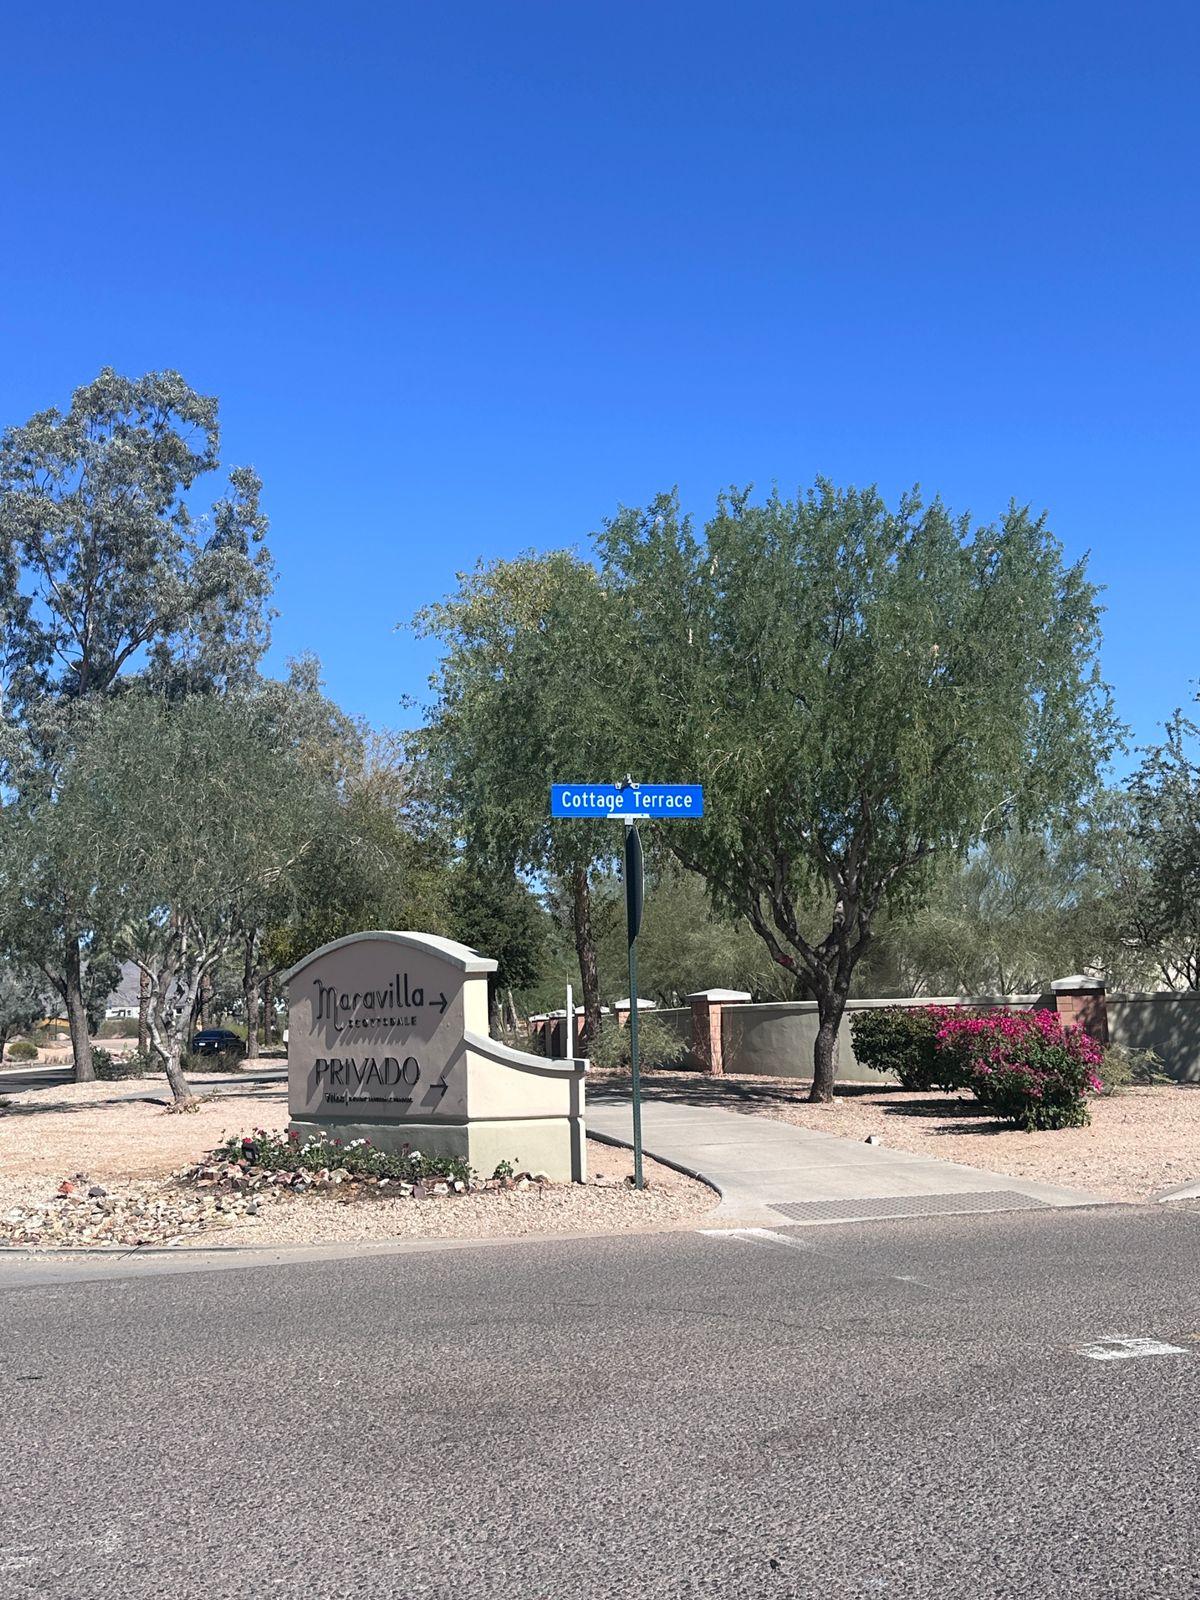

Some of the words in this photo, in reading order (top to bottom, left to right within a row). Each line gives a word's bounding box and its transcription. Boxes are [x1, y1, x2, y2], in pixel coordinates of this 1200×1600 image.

[562, 791, 624, 812] Cottage
[633, 792, 692, 808] Terrace
[313, 973, 424, 1031] Maravilla
[348, 1016, 417, 1028] SCOTTSDALE
[315, 1056, 421, 1086] PRIVADO
